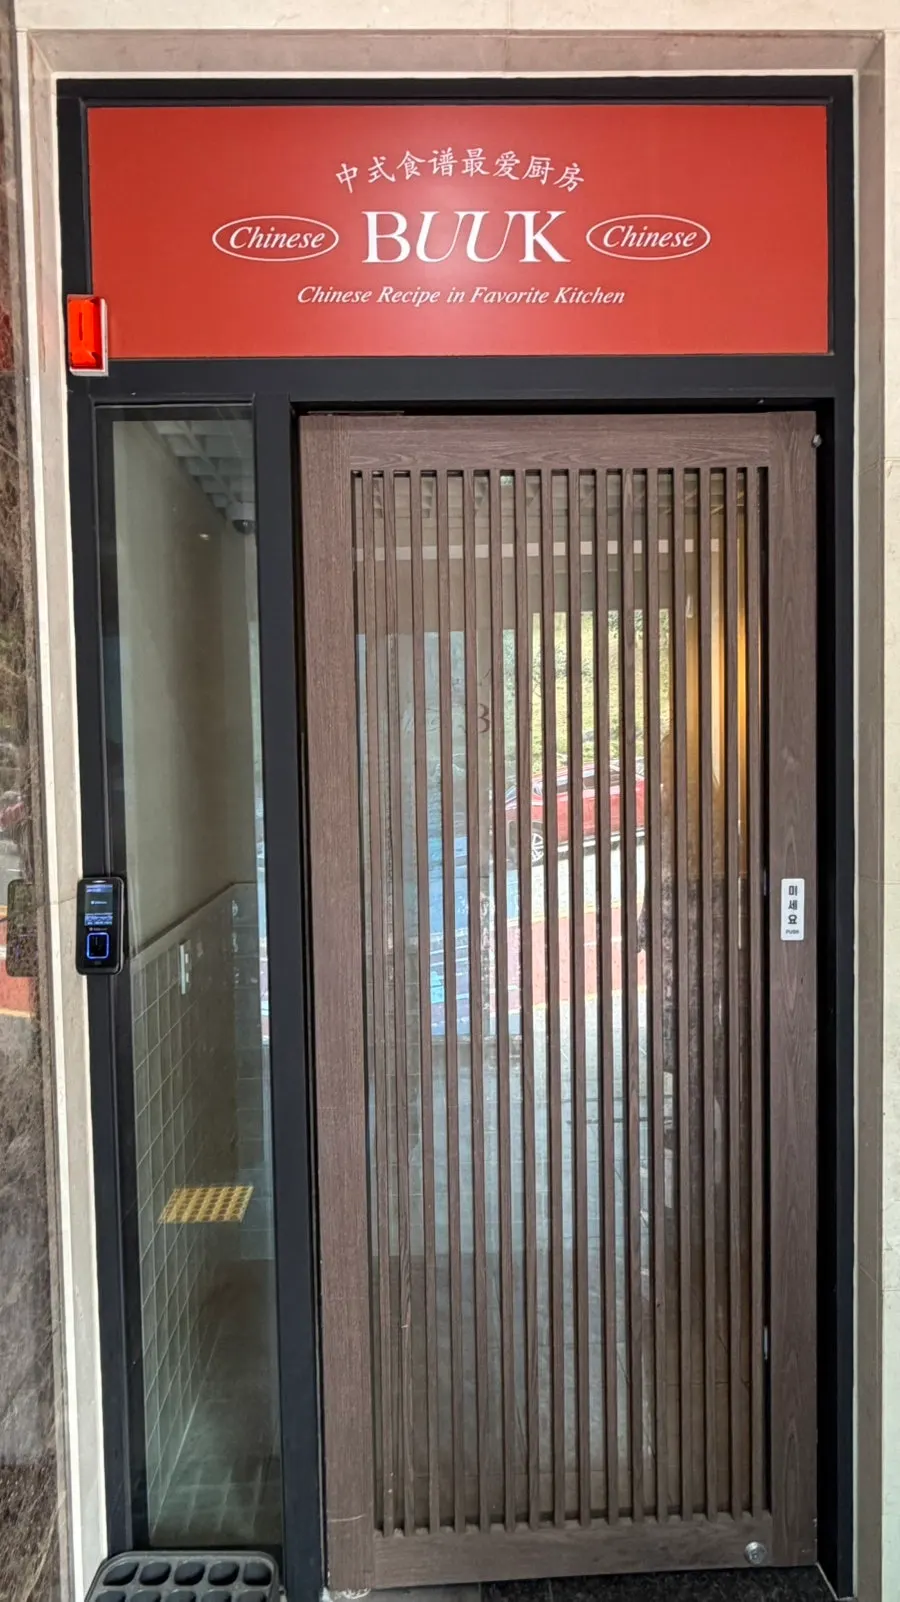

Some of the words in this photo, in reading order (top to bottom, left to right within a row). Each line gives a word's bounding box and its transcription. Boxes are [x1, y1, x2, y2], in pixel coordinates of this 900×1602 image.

[335, 146, 585, 194] 中式食谱最爱厨房
[229, 225, 326, 250] Chinese
[361, 210, 571, 263] BUUK
[602, 224, 698, 249] Chinese
[297, 285, 372, 304] Chinese
[376, 286, 441, 308] Recipe
[446, 286, 466, 304] in
[469, 285, 550, 304] Favorite
[554, 285, 625, 304] Kitchen
[787, 885, 798, 925] 미세요
